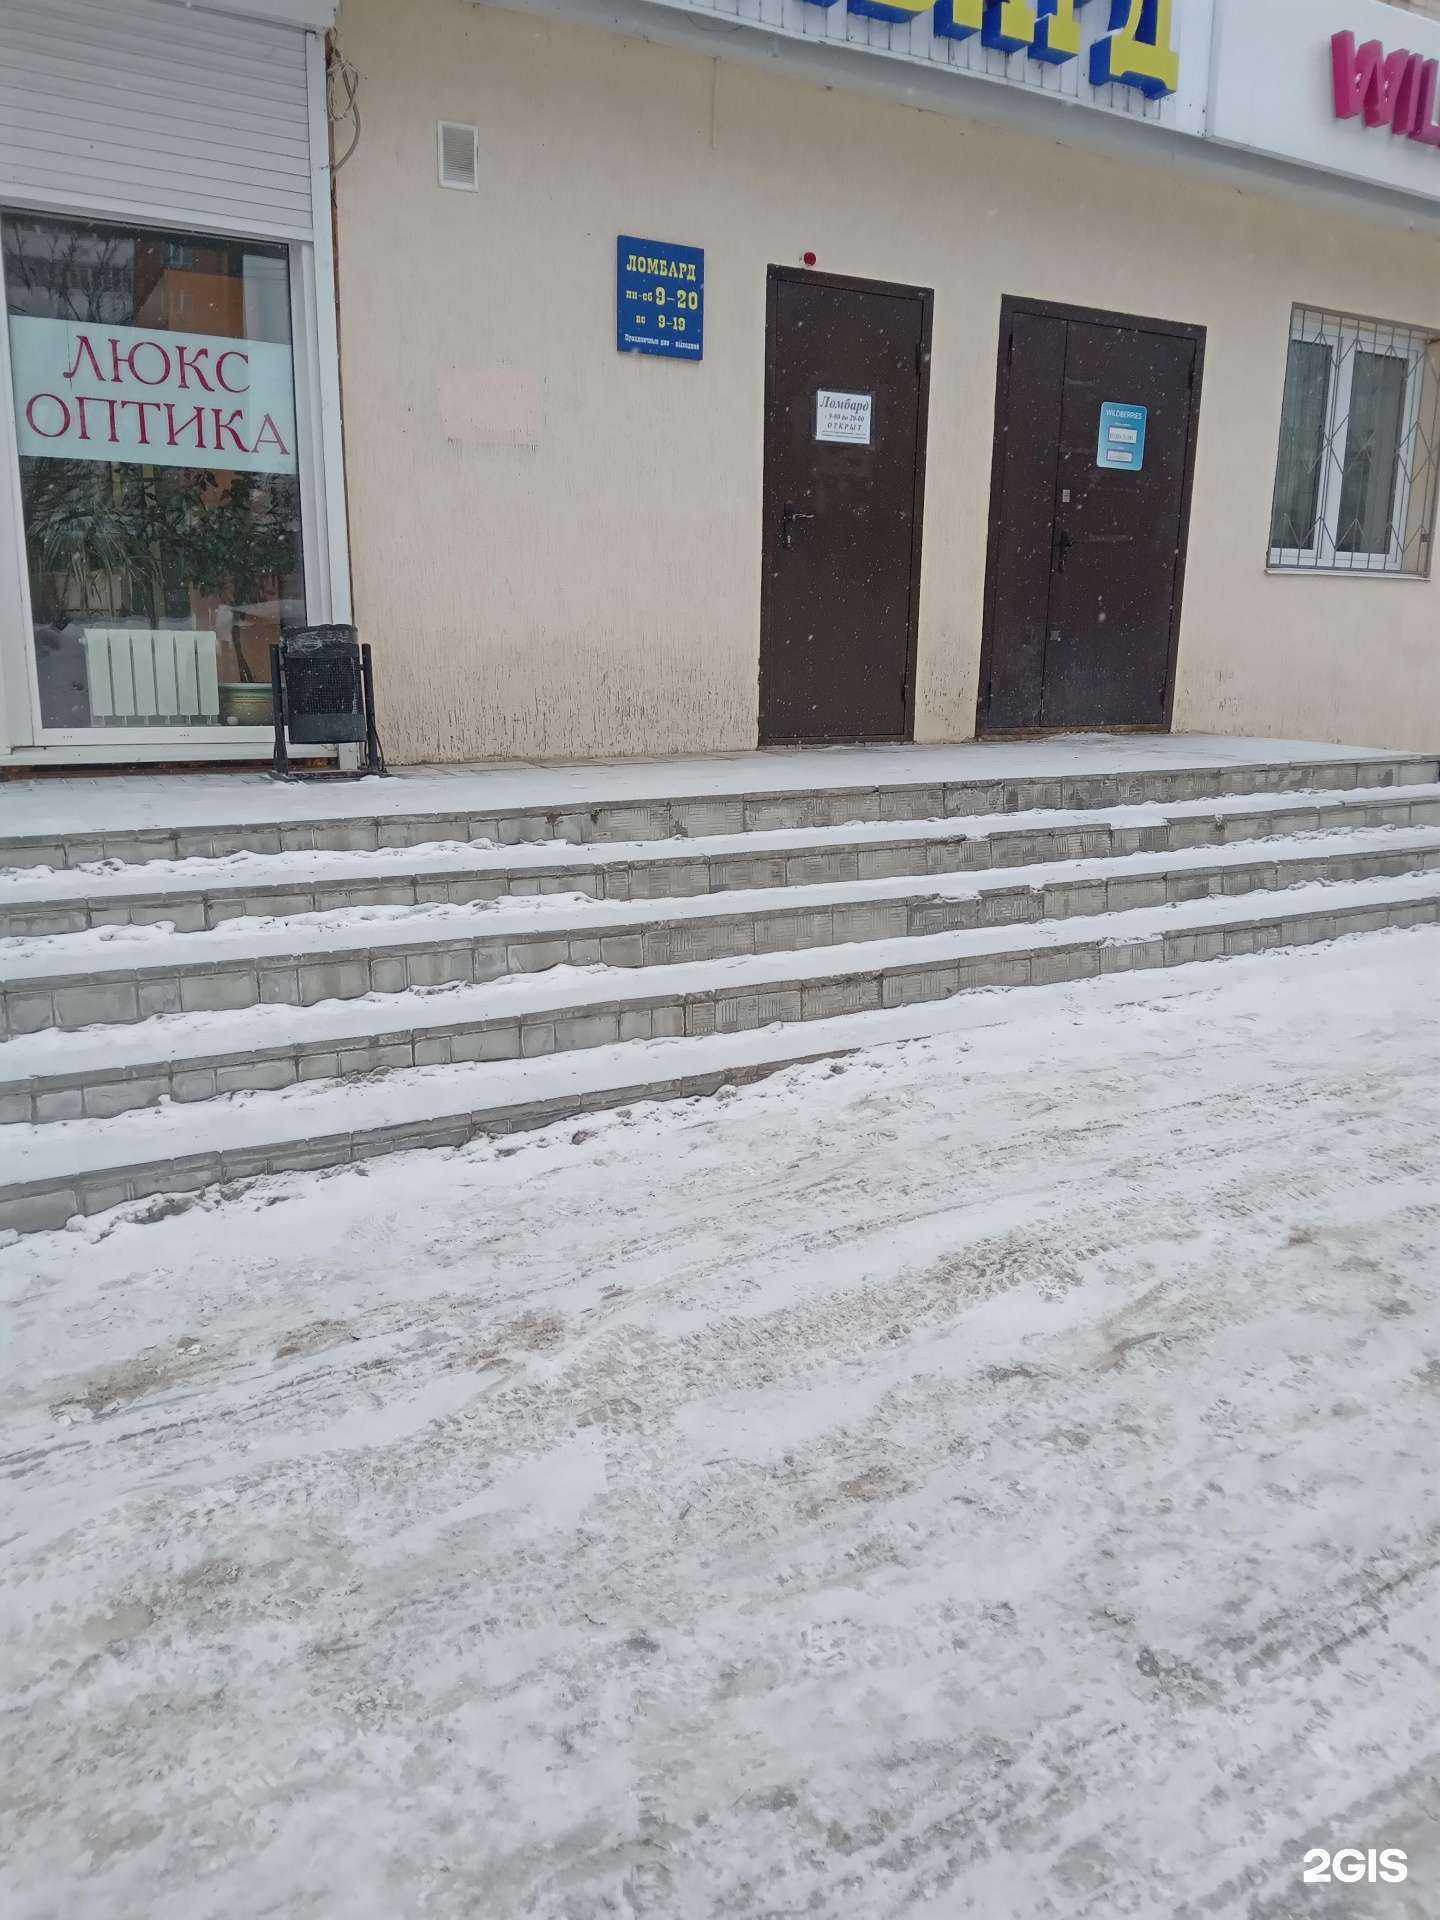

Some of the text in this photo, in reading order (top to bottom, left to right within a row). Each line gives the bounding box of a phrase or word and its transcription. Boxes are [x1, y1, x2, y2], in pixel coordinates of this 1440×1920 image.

[626, 255, 696, 281] ЛОМБАРД
[626, 286, 698, 311] пн-сб 9-20
[635, 314, 646, 325] вс
[62, 335, 251, 394] ЛЮКС
[819, 396, 869, 414] Ломбард
[26, 393, 291, 456] ОПТИКА
